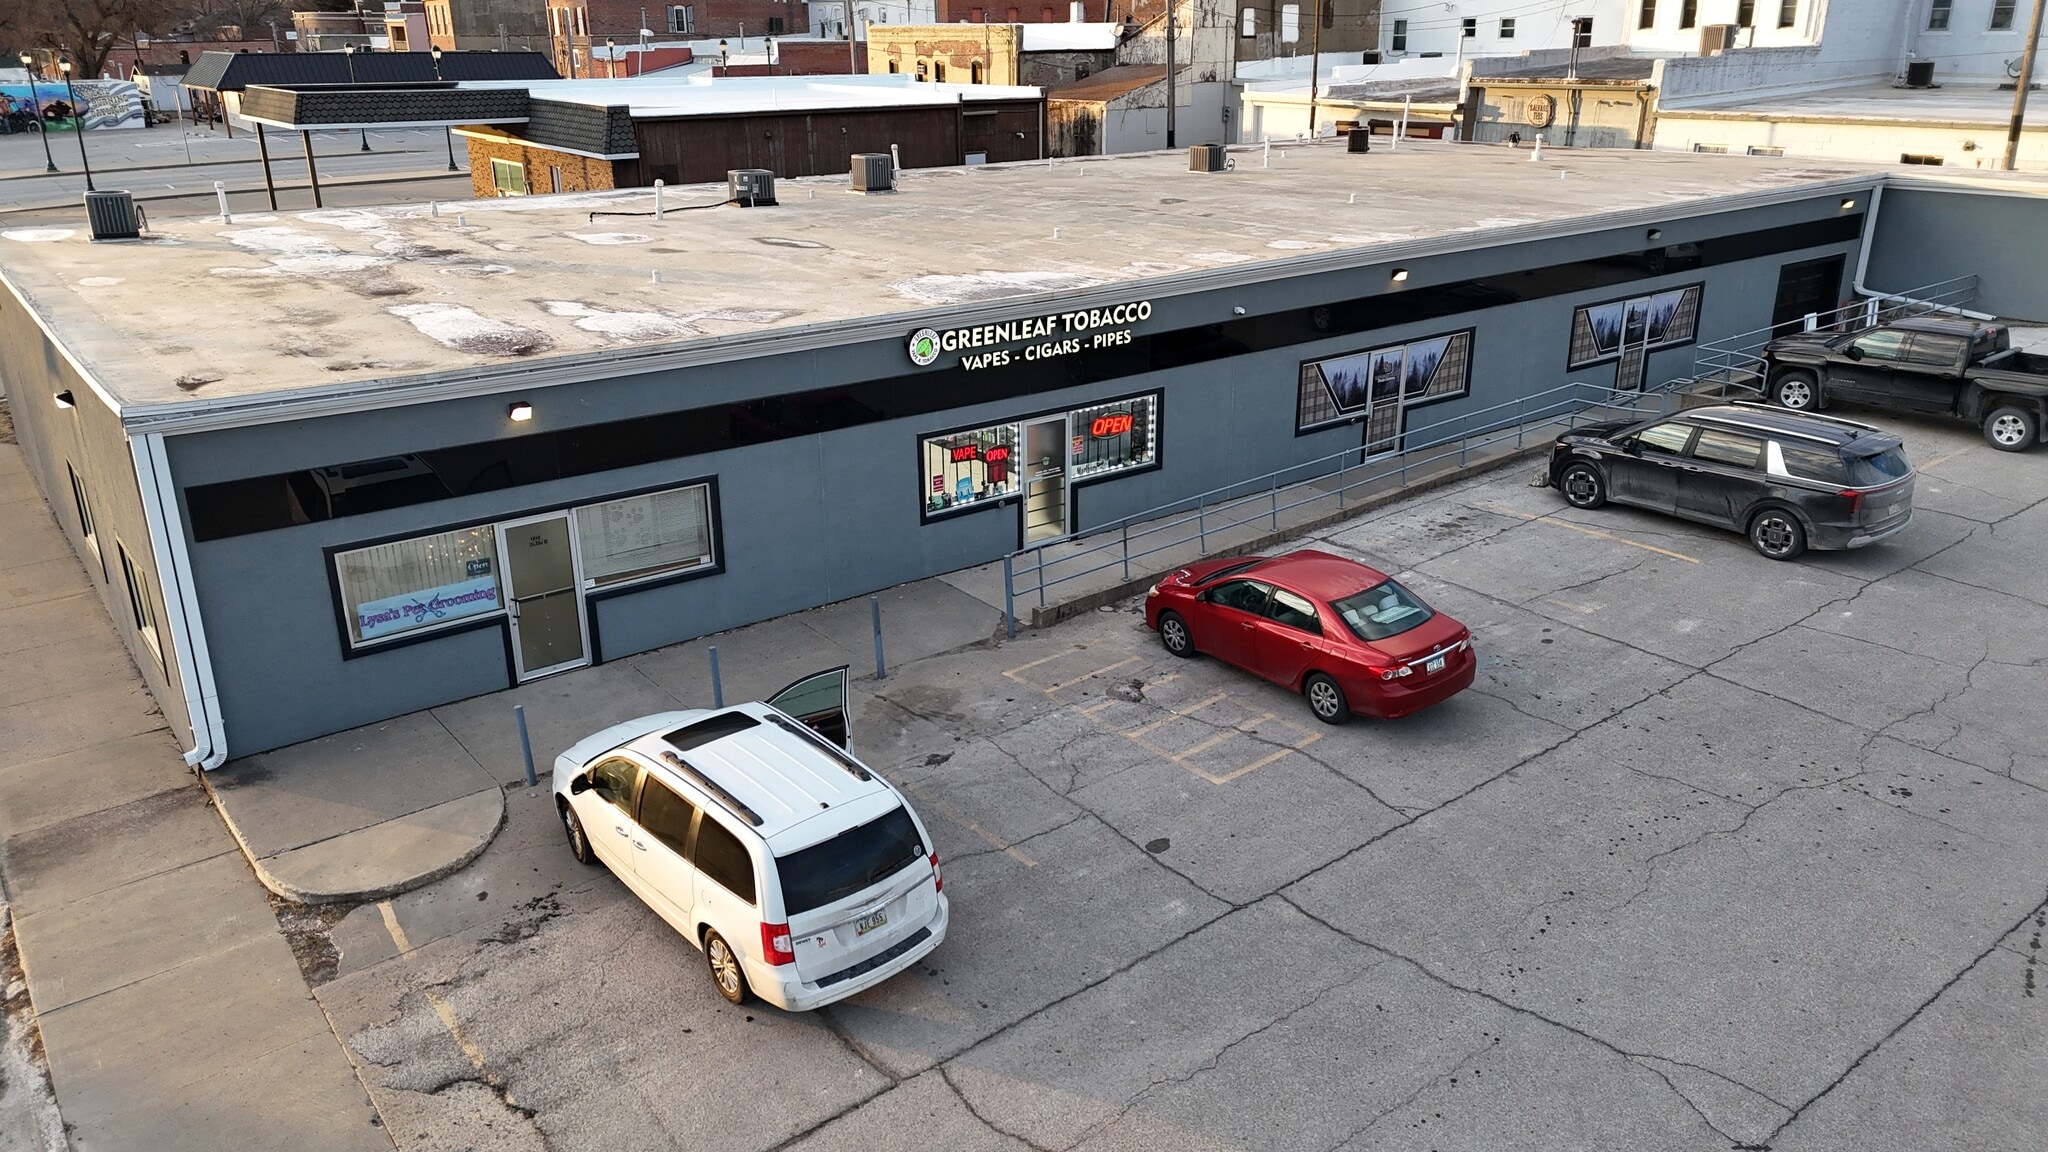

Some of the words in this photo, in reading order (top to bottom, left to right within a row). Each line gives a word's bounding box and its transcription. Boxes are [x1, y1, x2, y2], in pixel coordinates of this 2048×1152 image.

[941, 316, 1057, 352] GREENLEAF
[1062, 301, 1152, 332] TOBACCO
[961, 350, 1010, 372] VAPES
[1025, 339, 1080, 361] CIGARS
[1093, 329, 1132, 350] PIPES
[1092, 415, 1133, 436] OPEN
[953, 446, 977, 461] VAPE
[986, 448, 1008, 462] OPEN
[467, 562, 489, 571] Open
[359, 608, 400, 629] Lysa's
[428, 587, 496, 610] Grooming
